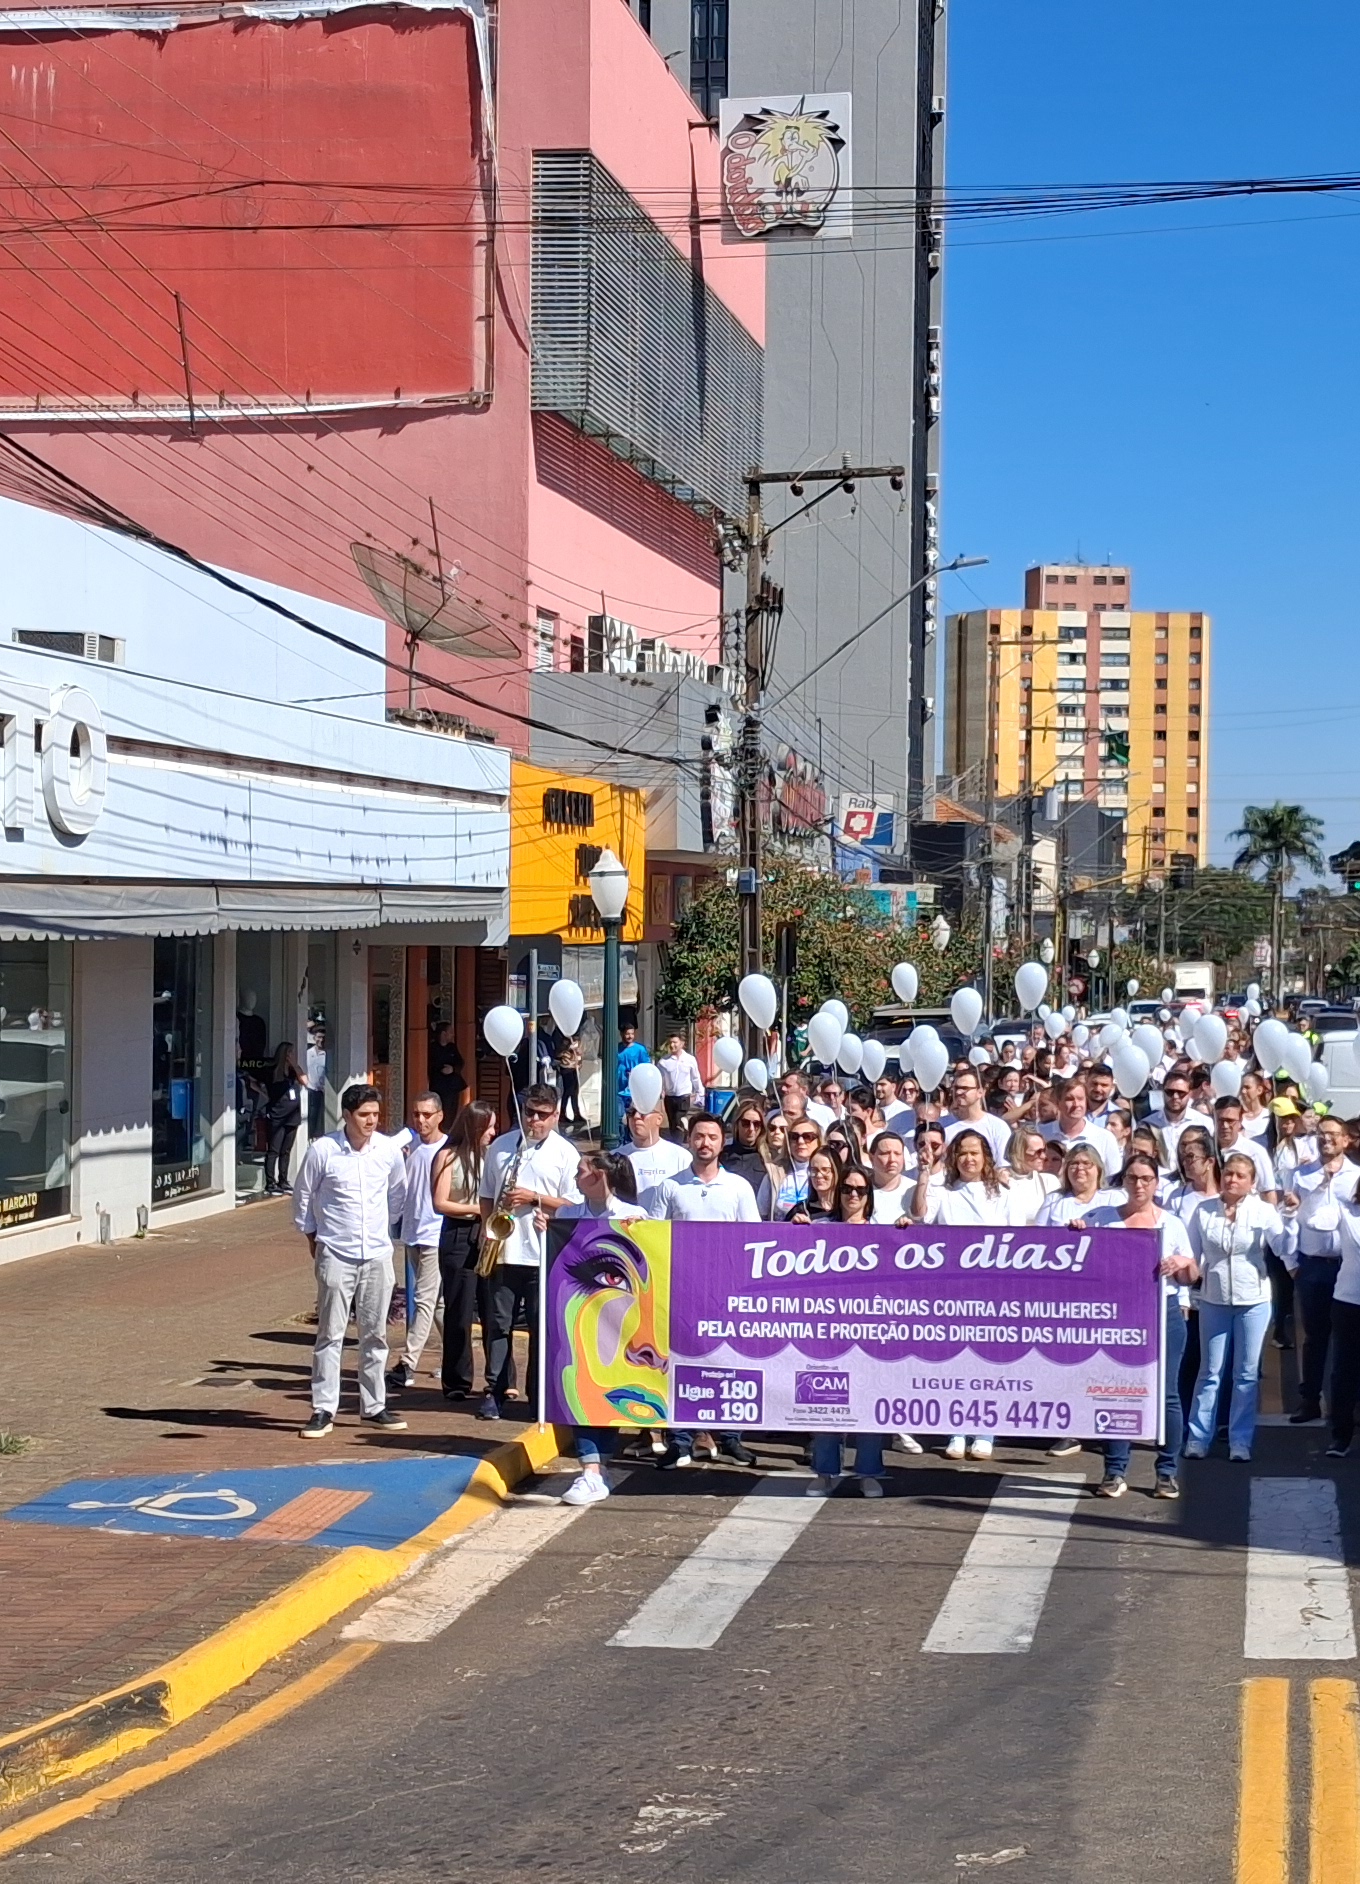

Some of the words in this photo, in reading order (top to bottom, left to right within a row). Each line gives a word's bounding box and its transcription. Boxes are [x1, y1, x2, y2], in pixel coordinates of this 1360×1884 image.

[3, 1192, 38, 1212] MARCATO
[743, 1239, 880, 1279] Todos
[894, 1242, 946, 1270] os
[727, 1295, 768, 1313] PELO
[771, 1296, 800, 1314] FIM
[803, 1297, 836, 1315] DAS
[838, 1293, 930, 1317] VIOLÊNCIAS
[933, 1299, 997, 1318] CONTRA
[998, 1300, 1021, 1318] AS
[1024, 1301, 1118, 1320] MULHERES!
[697, 1320, 737, 1337] PELA
[739, 1320, 814, 1339] GARANTIA
[817, 1322, 827, 1339] E
[830, 1321, 909, 1345] PROTEÇÃO
[912, 1324, 946, 1342] DOS
[949, 1325, 1018, 1343] DIREITOS
[1021, 1326, 1054, 1344] DAS
[1056, 1327, 1148, 1346] MULHERES!
[677, 1383, 716, 1401] Ligue
[719, 1380, 758, 1399] 180
[812, 1376, 848, 1390] CAM
[911, 1377, 965, 1390] LIGUE
[969, 1376, 1034, 1392] GRÁTIS
[697, 1408, 716, 1421] ou
[720, 1402, 758, 1422] 190
[874, 1397, 941, 1427] 0800
[948, 1398, 999, 1428] 645
[1005, 1400, 1072, 1430] 4479
